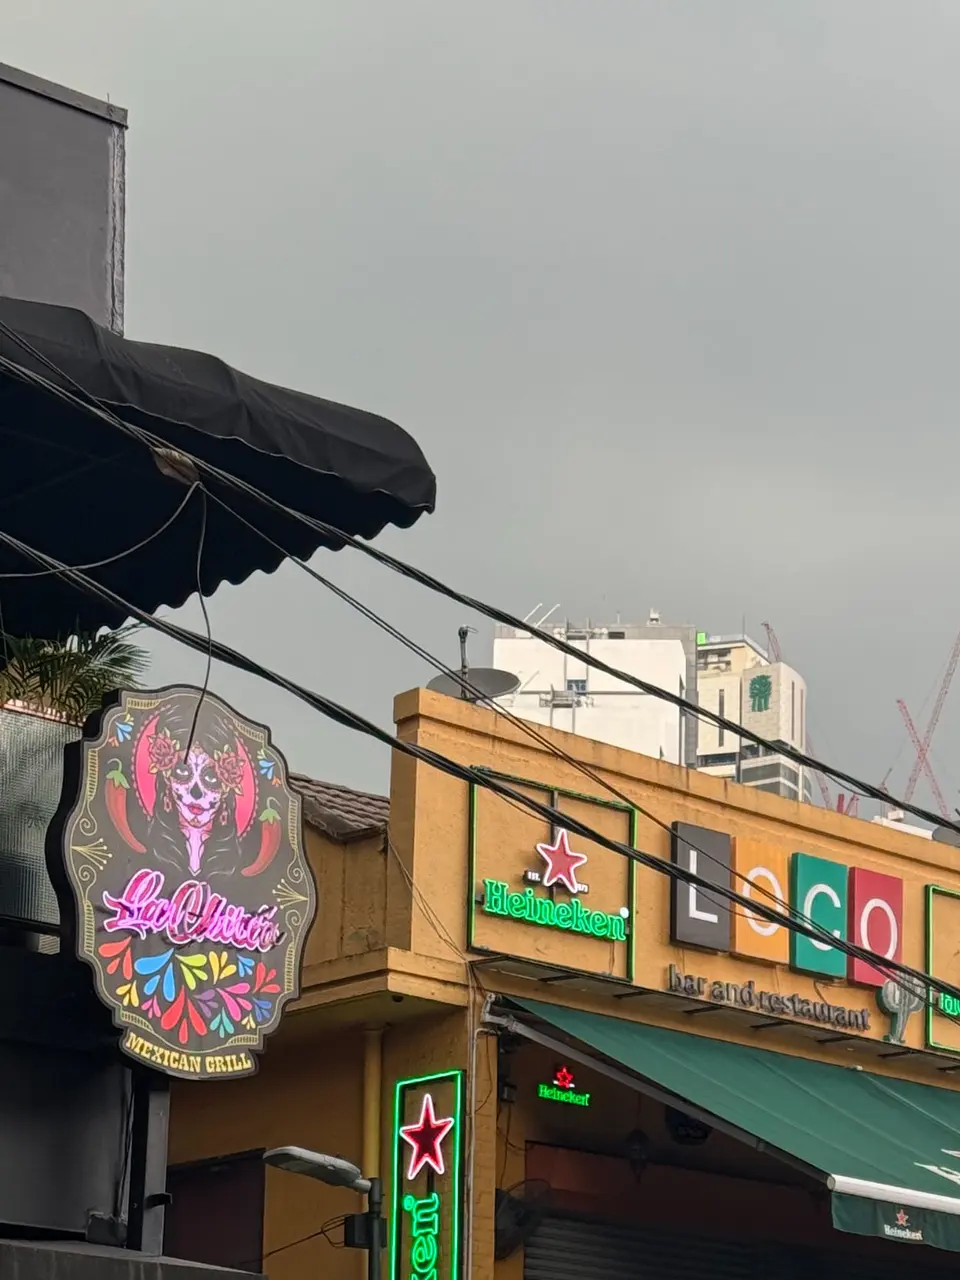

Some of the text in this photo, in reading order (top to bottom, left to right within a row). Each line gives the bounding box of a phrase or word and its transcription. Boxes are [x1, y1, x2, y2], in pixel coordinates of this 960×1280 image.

[484, 879, 627, 941] Heineken
[688, 849, 899, 964] LOCO
[667, 963, 872, 1032] bar and restaurant
[125, 1032, 252, 1073] MEXICAN GRILL
[884, 1224, 923, 1241] Heineken
